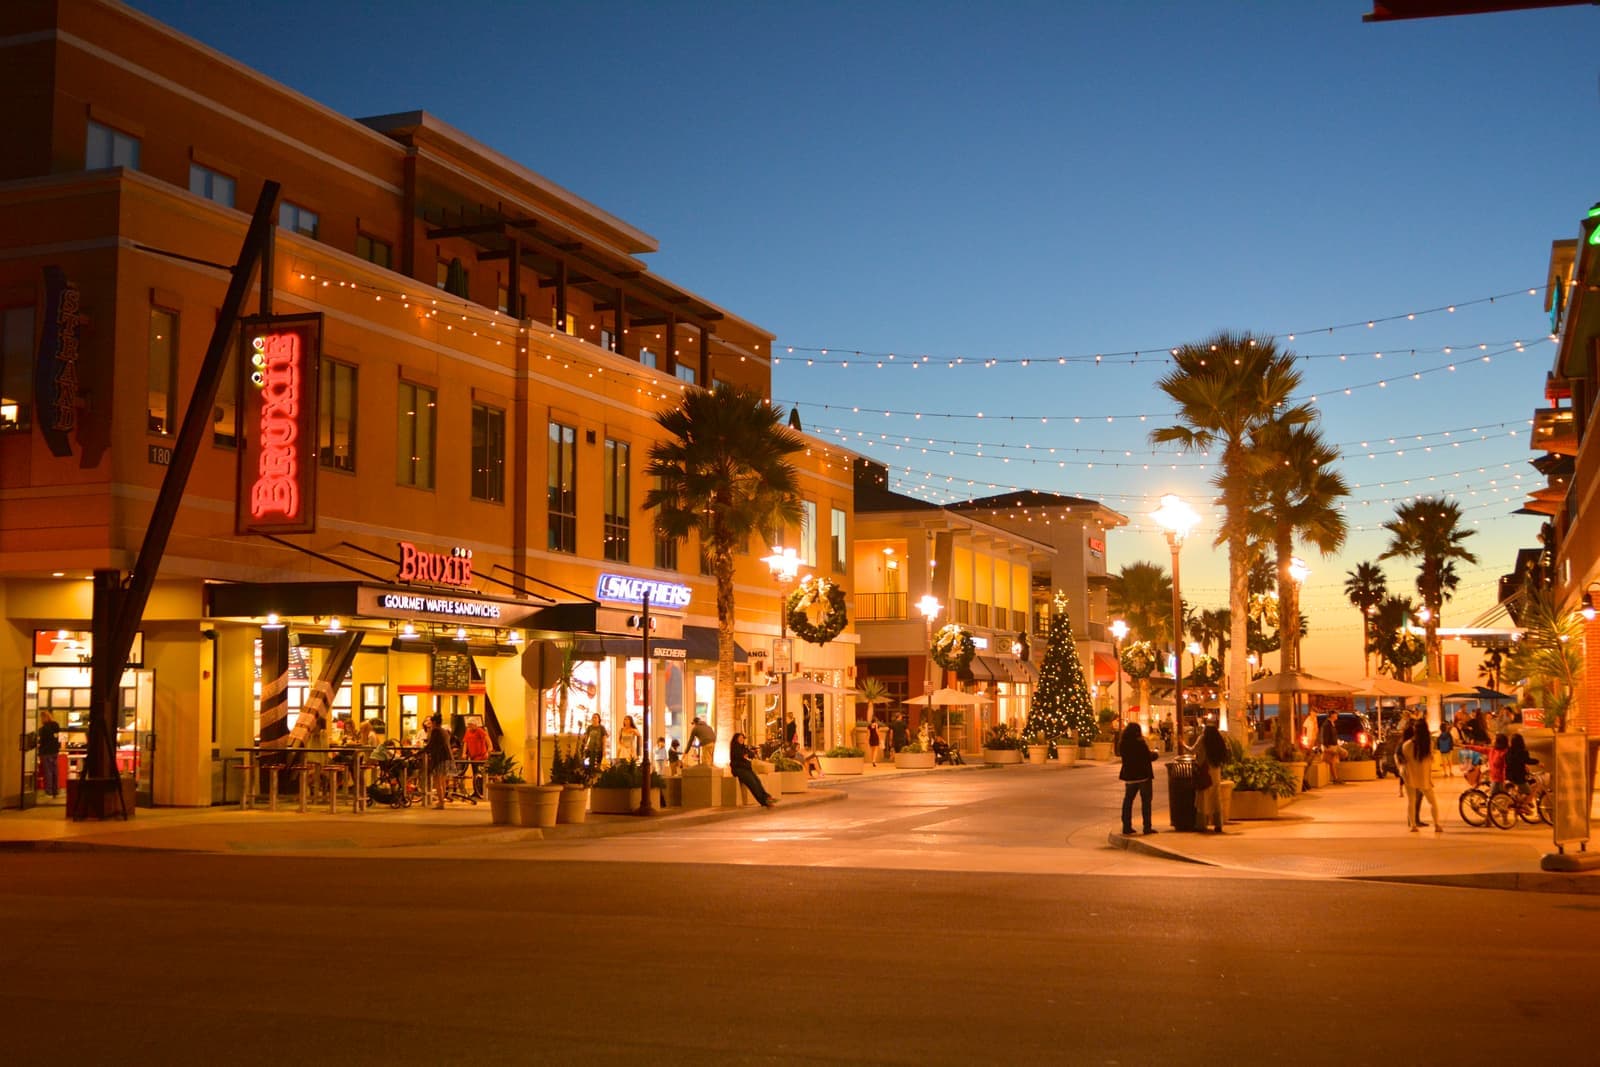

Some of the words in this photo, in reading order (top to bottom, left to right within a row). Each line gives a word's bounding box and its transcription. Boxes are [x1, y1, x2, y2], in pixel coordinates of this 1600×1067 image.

[252, 334, 299, 516] BRUXIE
[606, 576, 692, 606] SKECHERS
[384, 594, 424, 611] GOURMET
[425, 598, 453, 614] WAFFLE
[454, 602, 501, 618] SANDWICHES
[653, 647, 687, 657] SKECHERS
